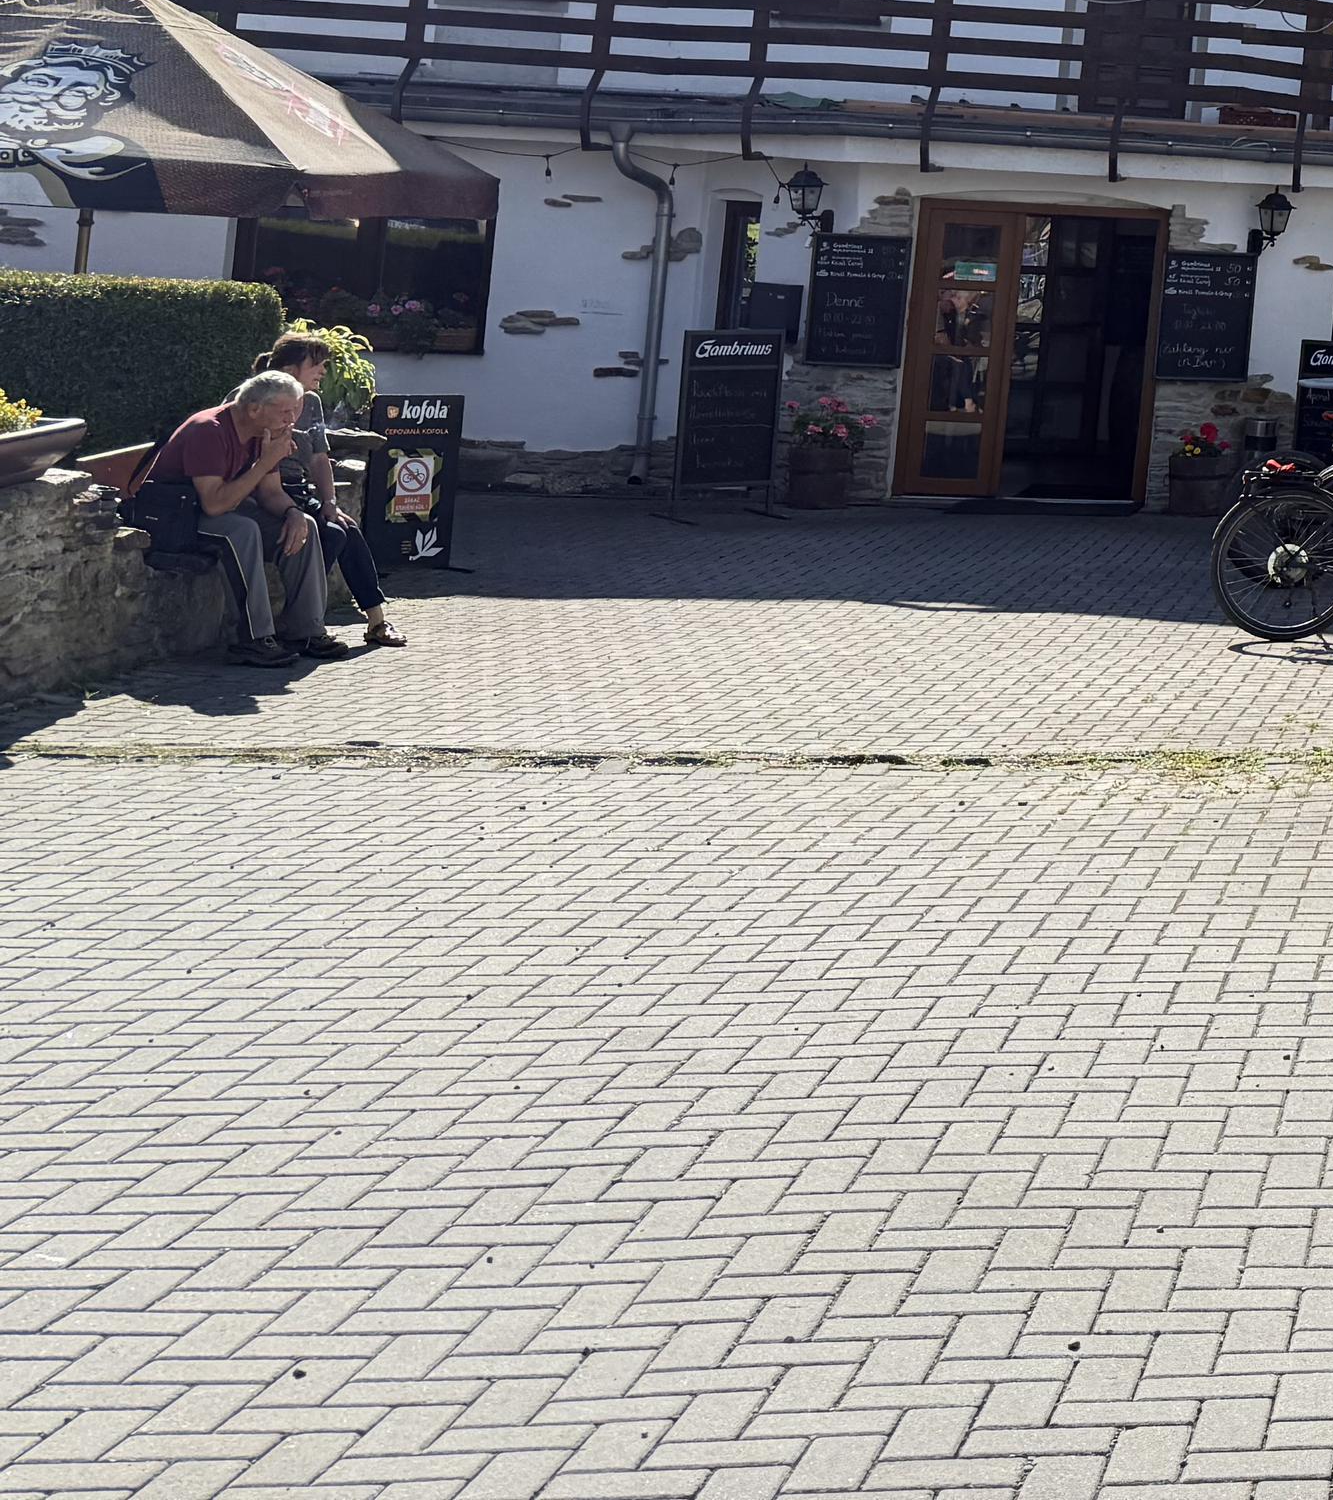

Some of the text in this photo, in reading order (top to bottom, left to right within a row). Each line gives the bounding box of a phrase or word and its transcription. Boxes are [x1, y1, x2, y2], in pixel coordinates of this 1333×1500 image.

[695, 339, 774, 359] Gambrinus
[401, 399, 449, 425] kofola
[421, 427, 450, 436] KOFOLA
